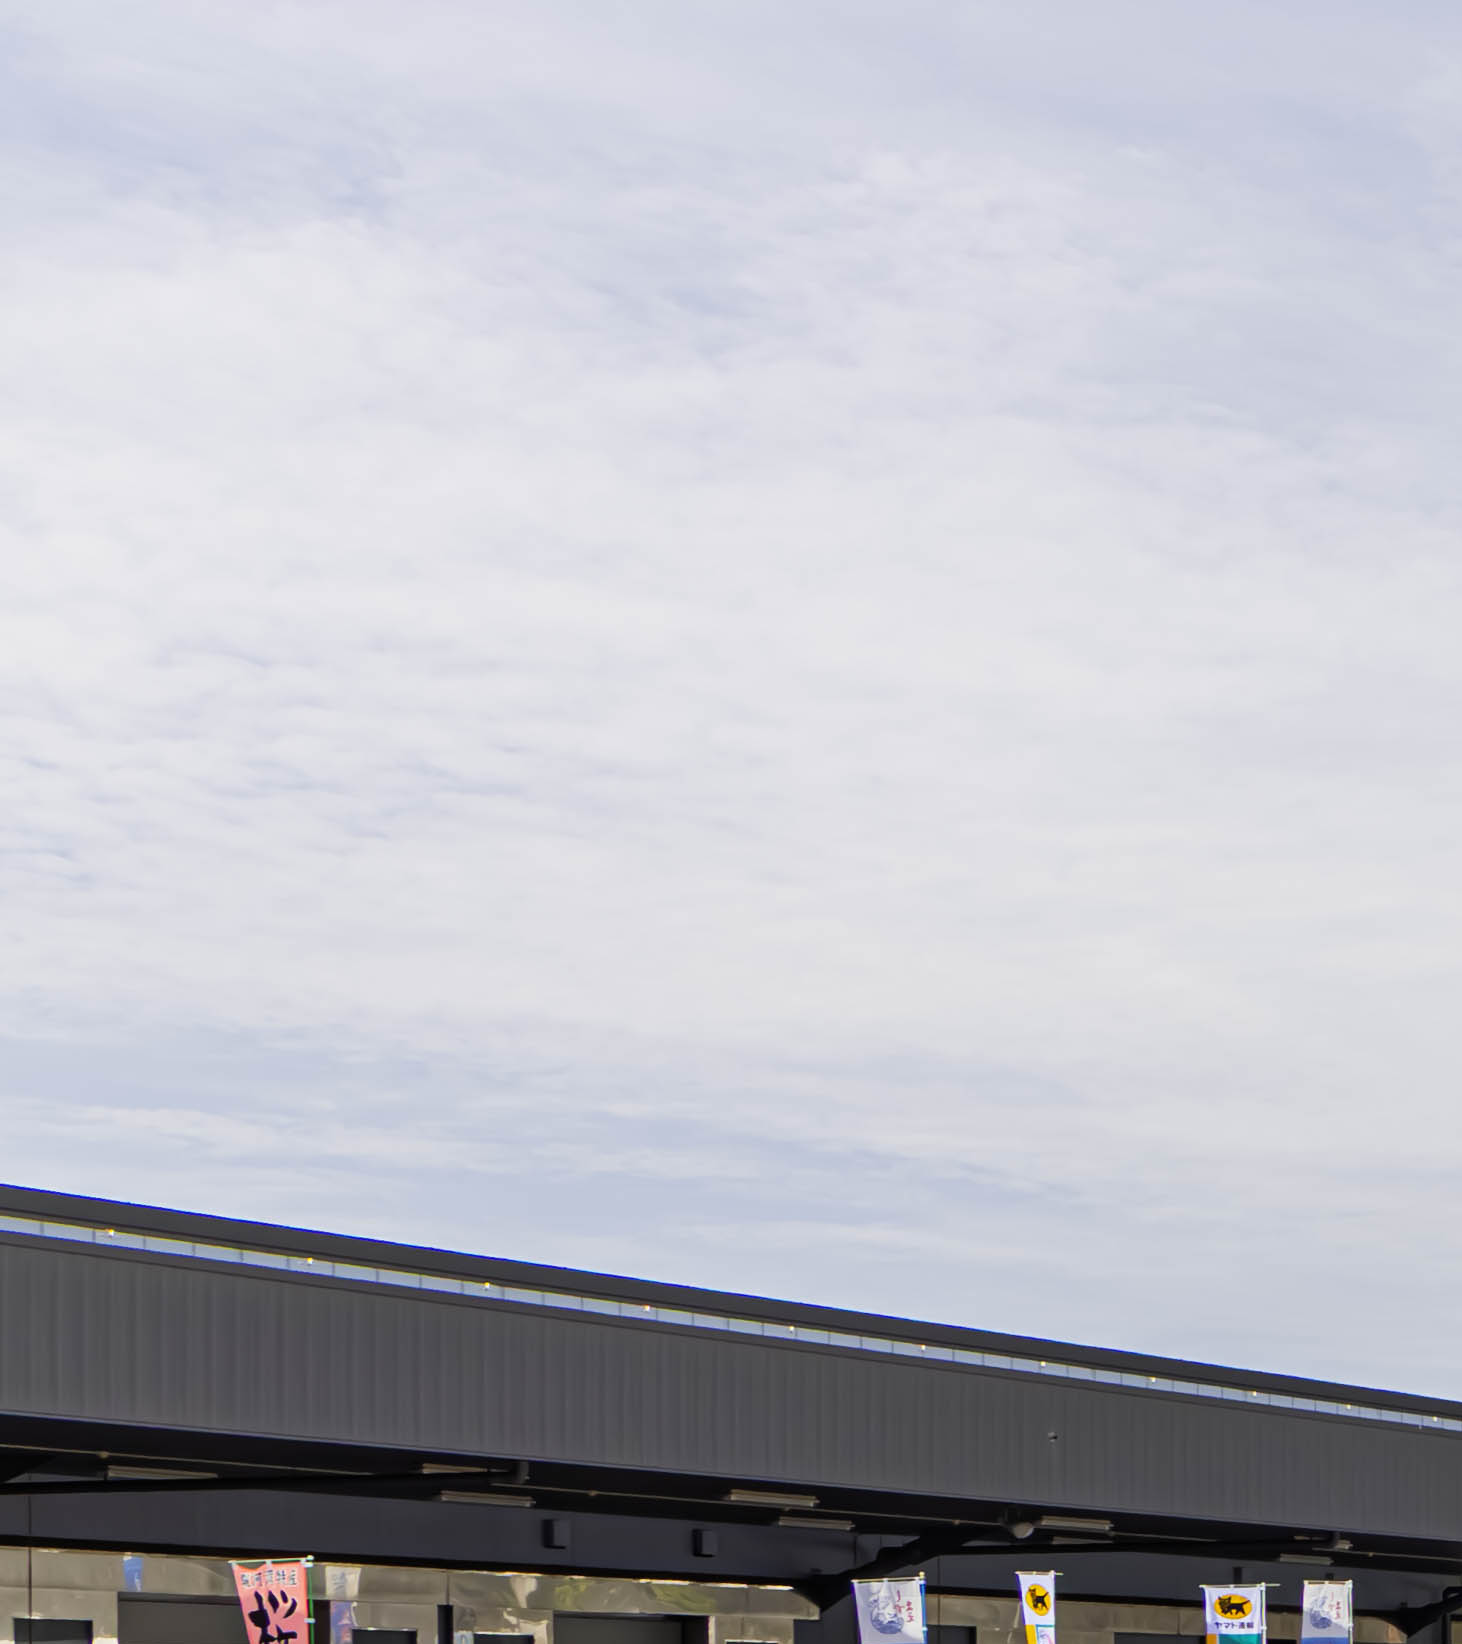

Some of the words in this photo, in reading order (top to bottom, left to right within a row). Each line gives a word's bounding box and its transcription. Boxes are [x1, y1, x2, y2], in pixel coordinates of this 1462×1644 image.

[1214, 1621, 1255, 1630] ヤマト運輸
